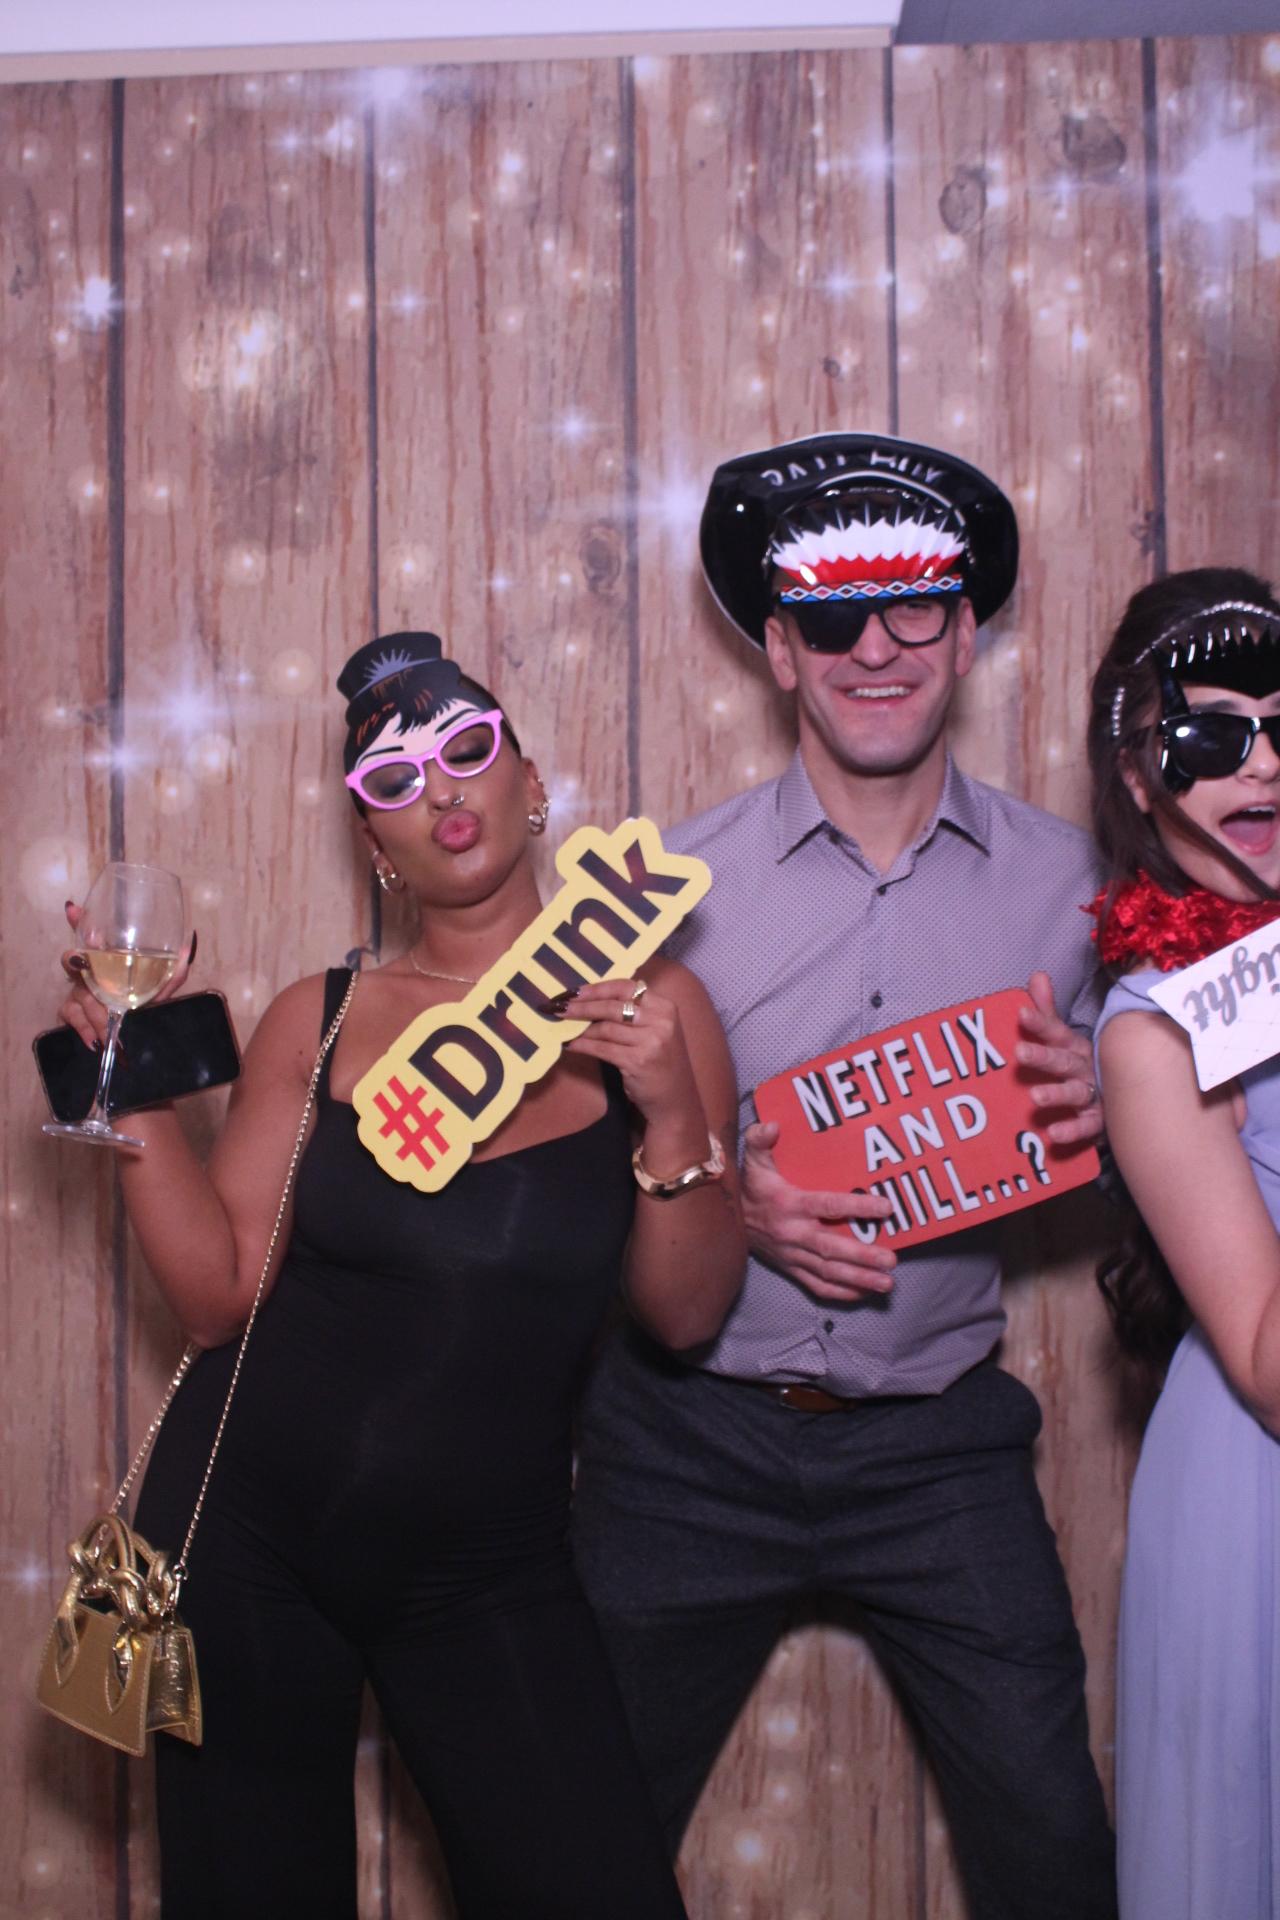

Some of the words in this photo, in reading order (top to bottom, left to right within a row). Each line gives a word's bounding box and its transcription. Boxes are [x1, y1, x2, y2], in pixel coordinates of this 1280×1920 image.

[372, 838, 691, 1172] #Drunk
[1183, 942, 1280, 1032] ight
[791, 1008, 1006, 1133] NETFLIX
[863, 1094, 988, 1172] AND
